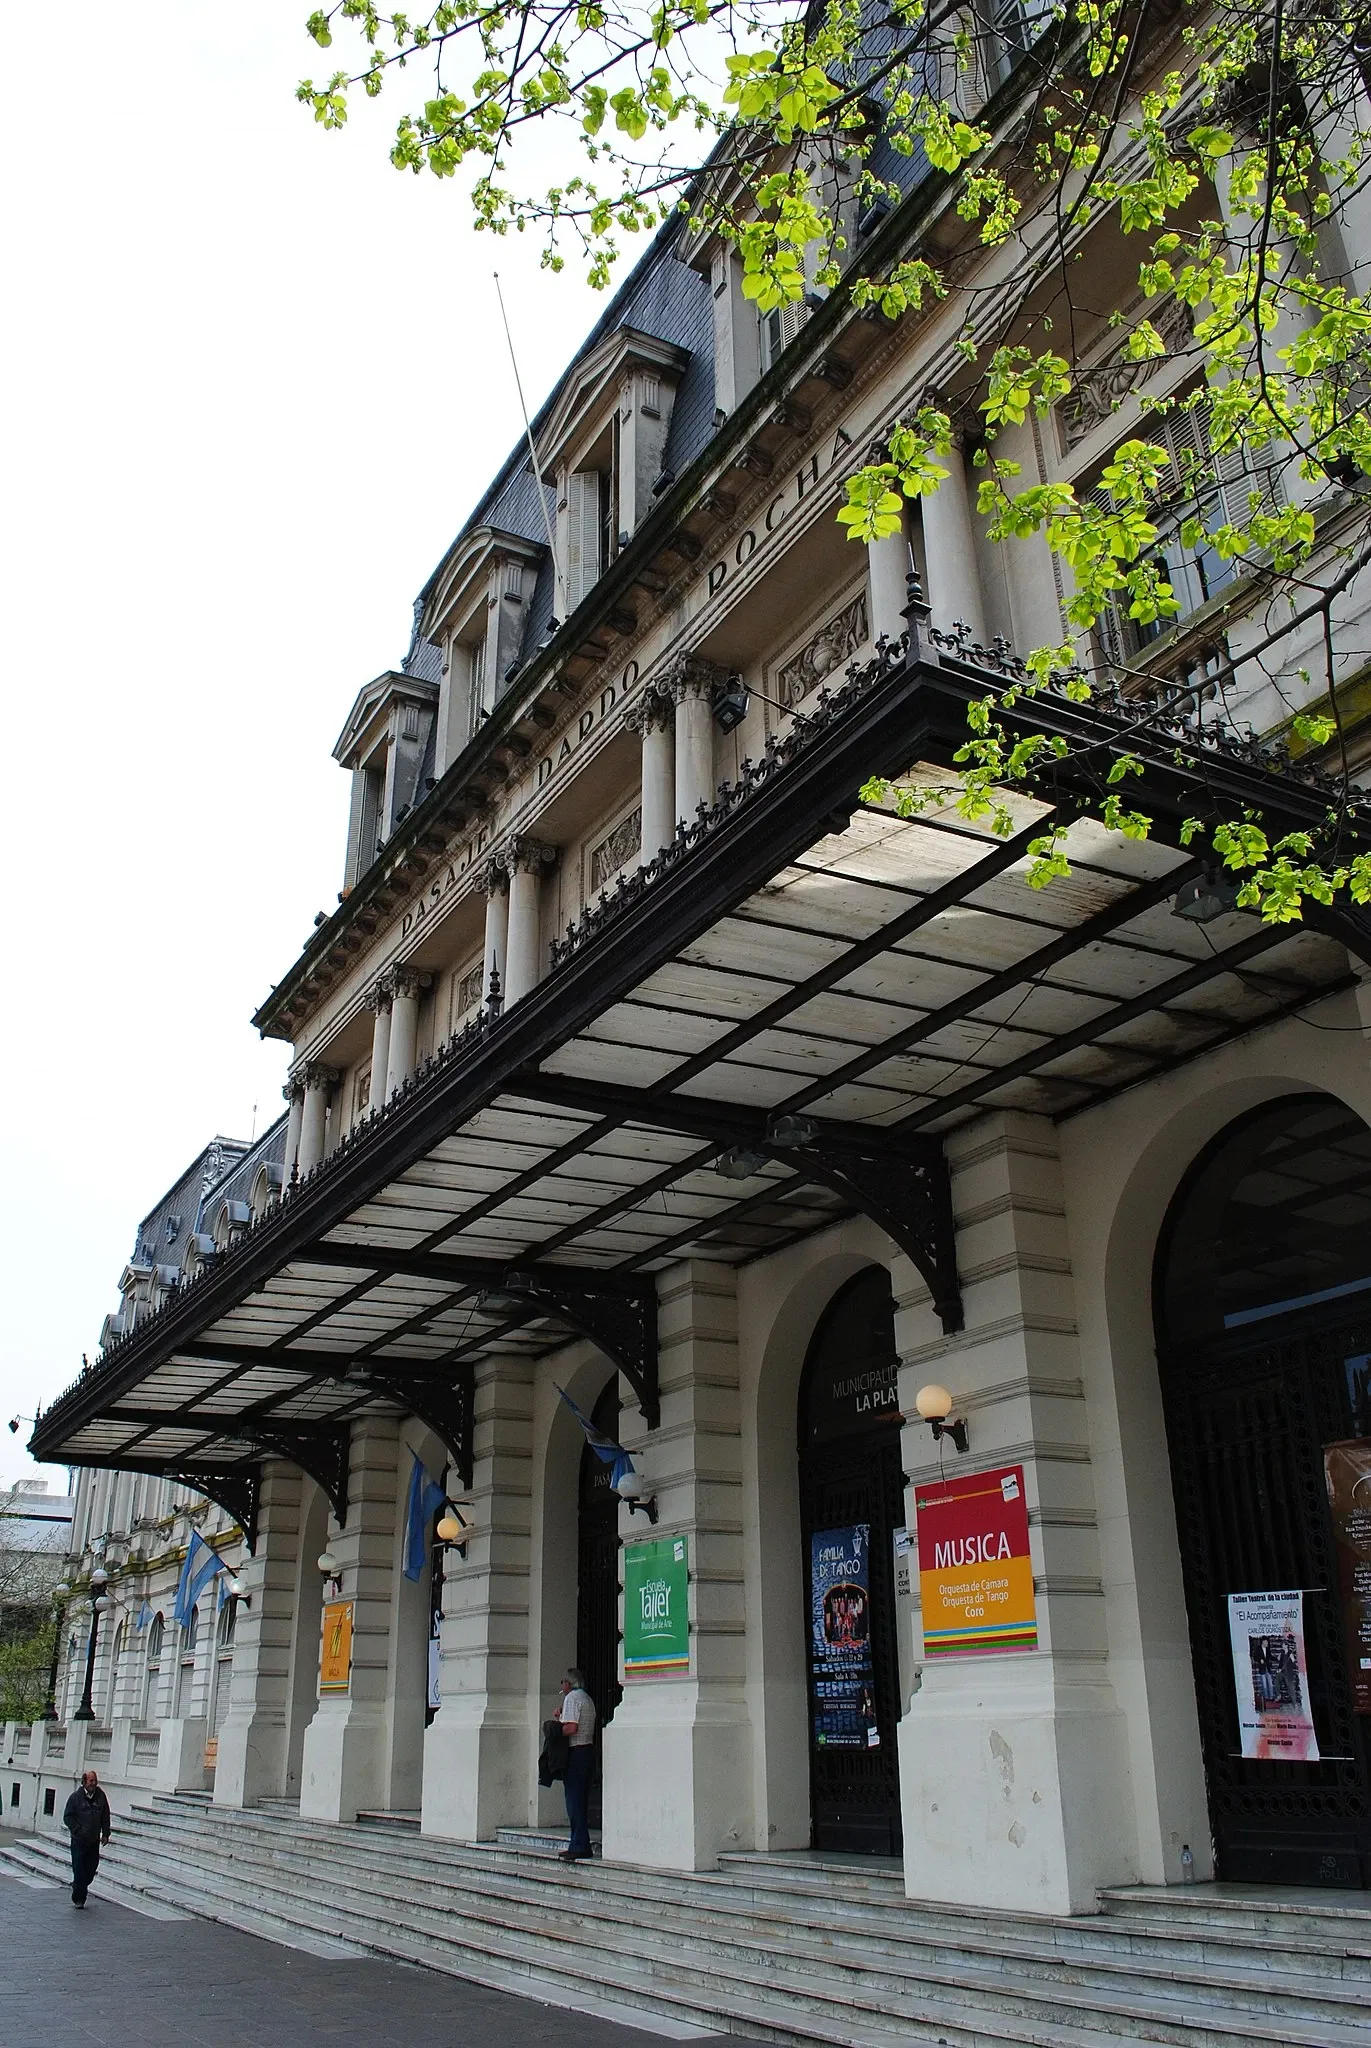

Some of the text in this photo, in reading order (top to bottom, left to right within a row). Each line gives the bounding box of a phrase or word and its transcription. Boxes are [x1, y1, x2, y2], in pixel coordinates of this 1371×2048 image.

[400, 427, 853, 939] PASAJE DARDO ROCHA
[856, 1394, 871, 1412] LA
[935, 1531, 1012, 1570] MUSICA
[819, 1559, 861, 1578] DE TANGO
[646, 1578, 666, 1594] Escuela
[939, 1578, 1009, 1595] Orquesta de Cámara
[942, 1591, 1009, 1608] Orquesta de Tango
[1248, 1594, 1266, 1602] Teatral
[1267, 1594, 1275, 1602] de
[1274, 1593, 1280, 1601] la
[1281, 1592, 1299, 1601] ciudad
[965, 1605, 985, 1618] Coro
